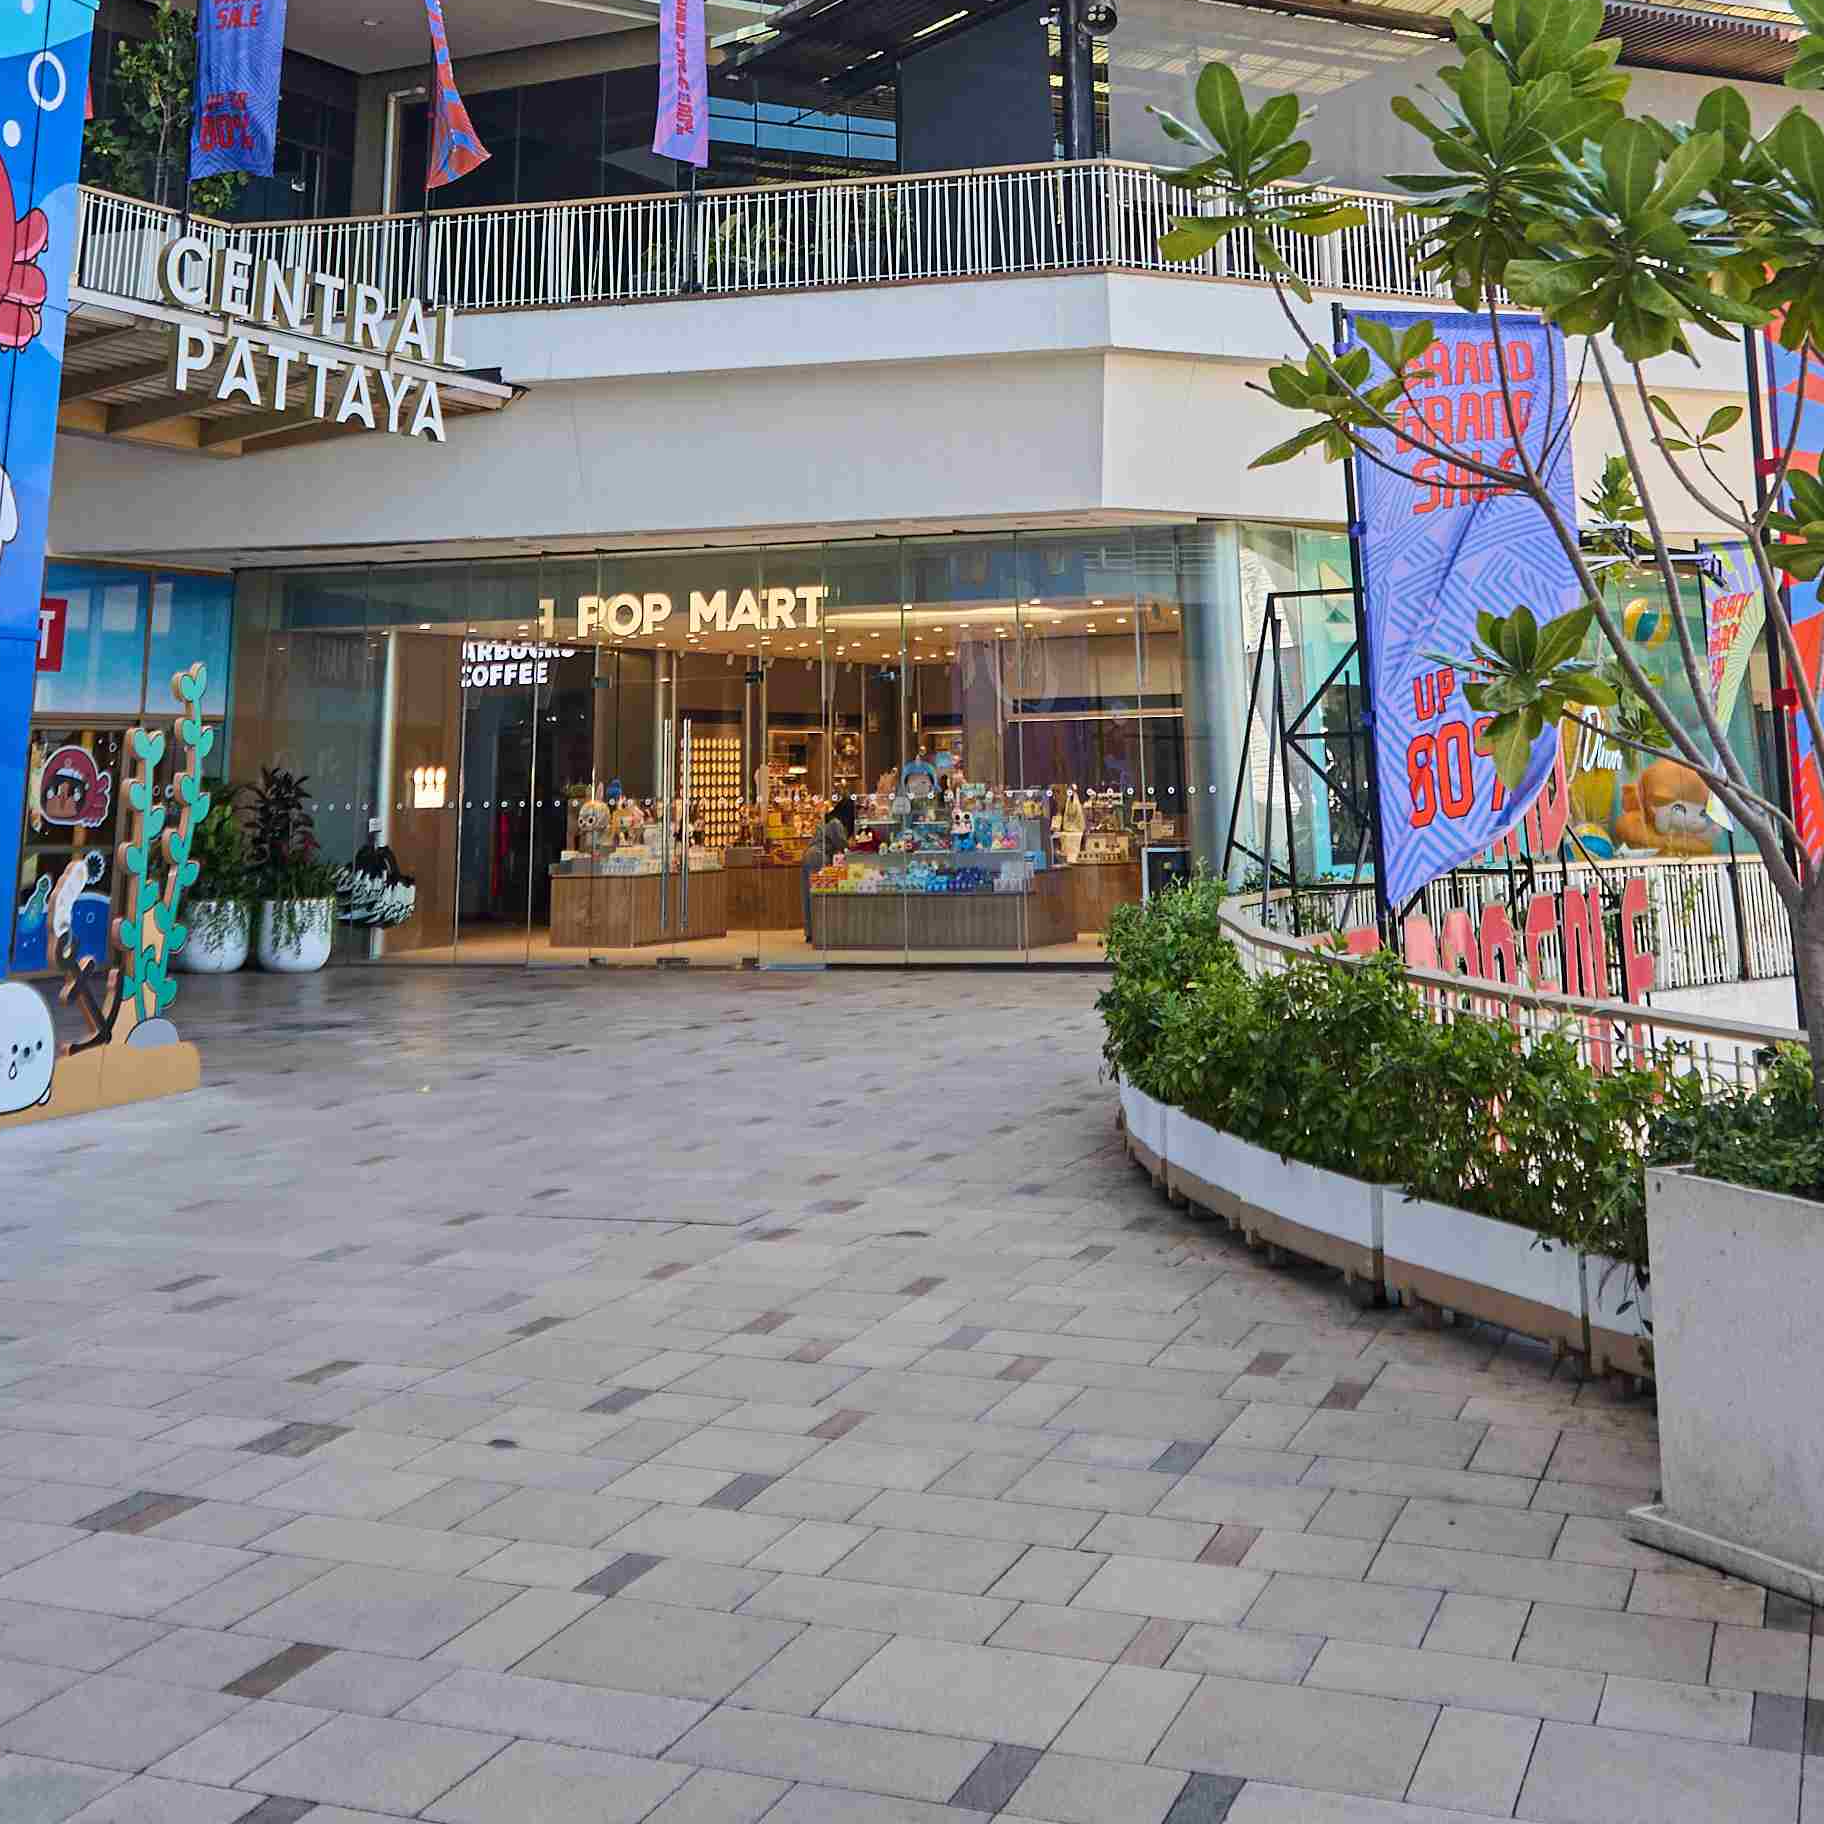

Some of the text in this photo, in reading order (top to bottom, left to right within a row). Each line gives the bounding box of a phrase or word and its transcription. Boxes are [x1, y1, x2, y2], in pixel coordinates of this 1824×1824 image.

[159, 236, 467, 369] CENTRAL
[173, 323, 446, 443] PATTAYA
[576, 592, 672, 638] POP
[688, 585, 829, 633] MART
[1413, 667, 1456, 722] UP
